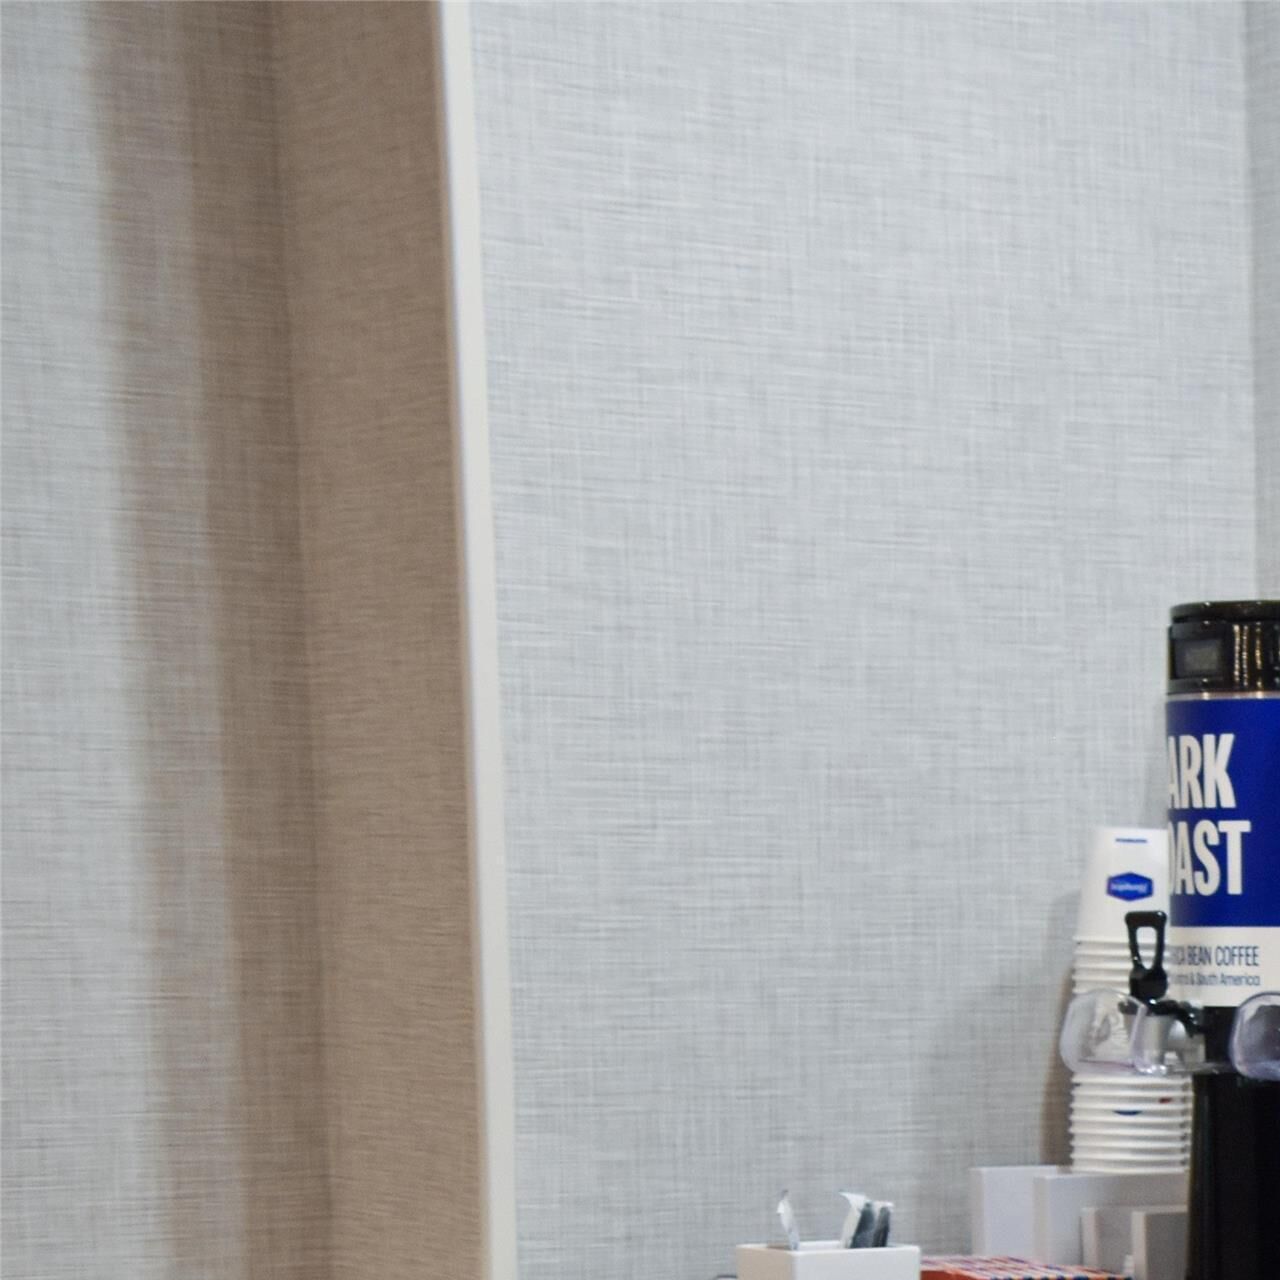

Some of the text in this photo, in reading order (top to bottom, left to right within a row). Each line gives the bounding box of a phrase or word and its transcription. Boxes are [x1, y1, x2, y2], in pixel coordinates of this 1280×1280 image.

[1187, 945, 1212, 967] BEAN
[1215, 945, 1260, 967] COFFEE
[1220, 972, 1260, 987] America
